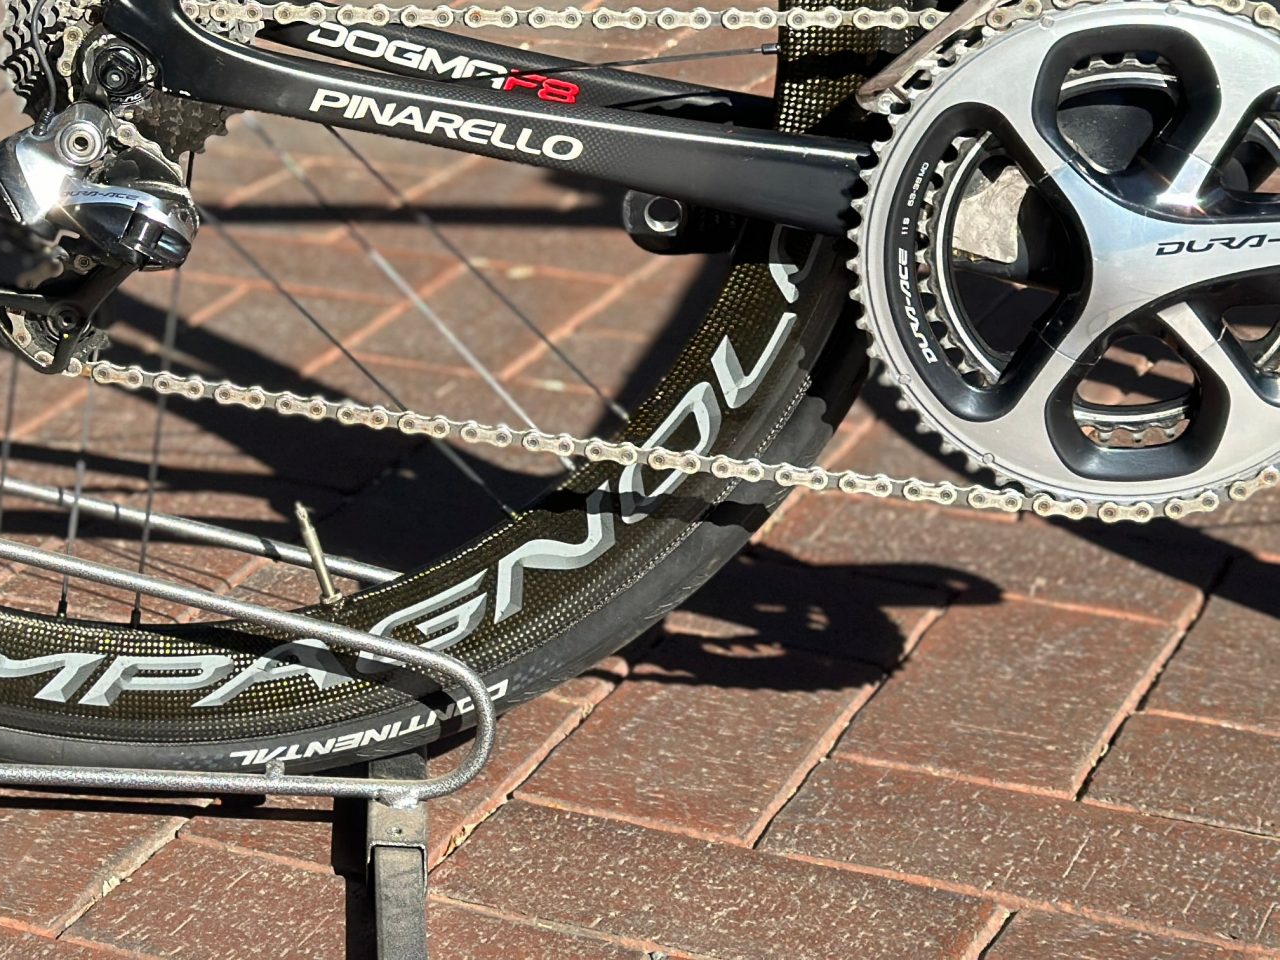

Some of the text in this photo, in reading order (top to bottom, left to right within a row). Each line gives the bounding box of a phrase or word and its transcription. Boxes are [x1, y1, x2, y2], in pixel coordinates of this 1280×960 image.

[306, 20, 580, 104] DOGMA F8
[309, 88, 584, 161] PINARELLO
[898, 247, 938, 364] DURA-ACE
